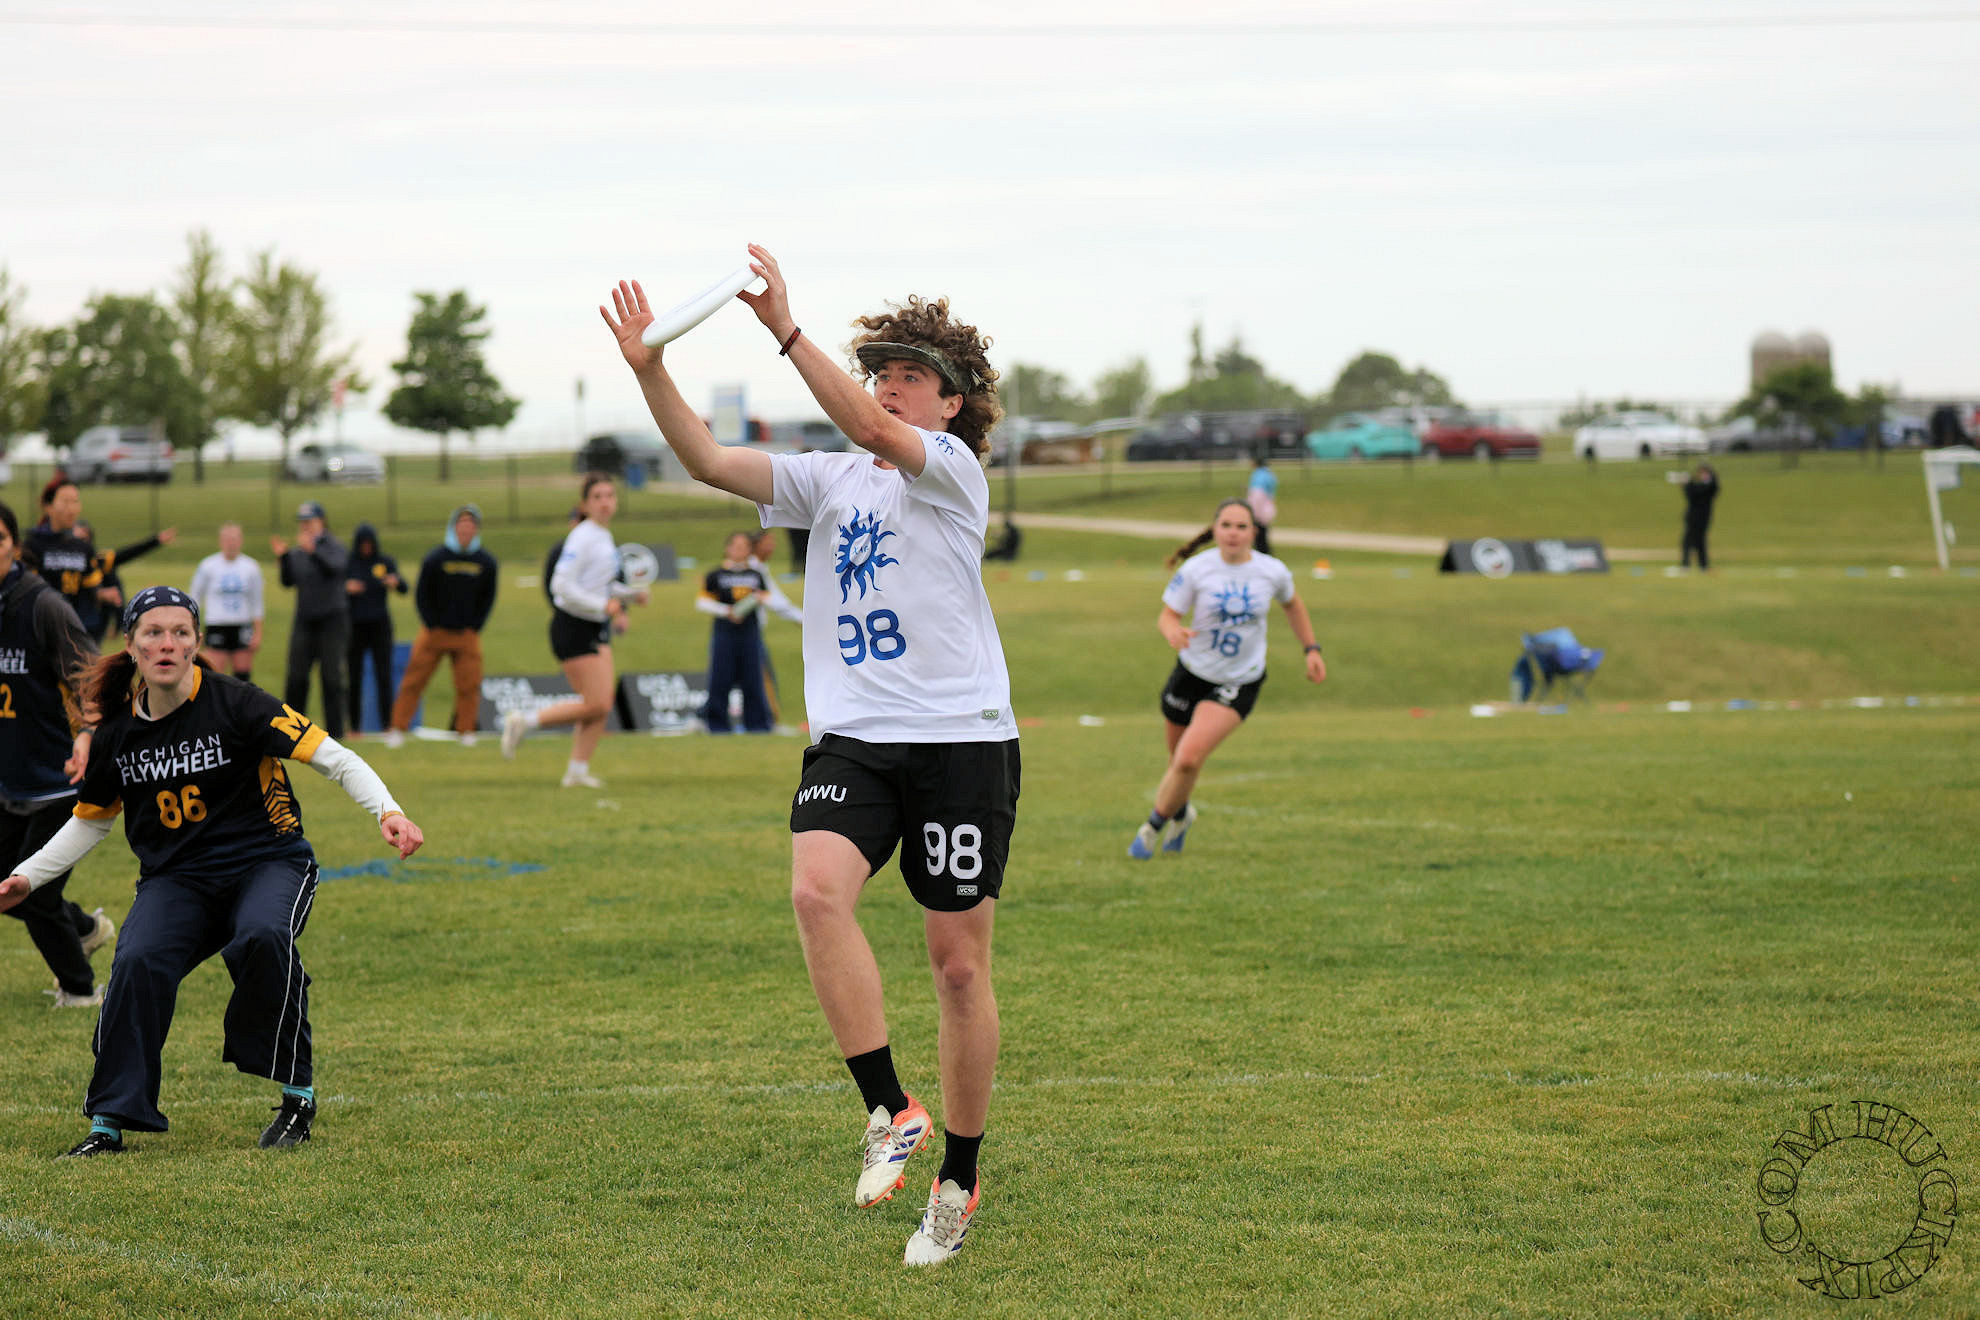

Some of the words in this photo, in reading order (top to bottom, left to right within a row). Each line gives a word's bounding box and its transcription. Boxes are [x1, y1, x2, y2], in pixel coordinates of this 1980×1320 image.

[837, 609, 906, 666] 98
[1210, 629, 1242, 657] 18
[270, 703, 311, 742] M
[116, 734, 221, 768] MICHIGAN
[121, 747, 231, 786] FLYWHEEL
[156, 784, 207, 829] 86
[798, 784, 848, 806] WWU
[923, 822, 982, 879] 98
